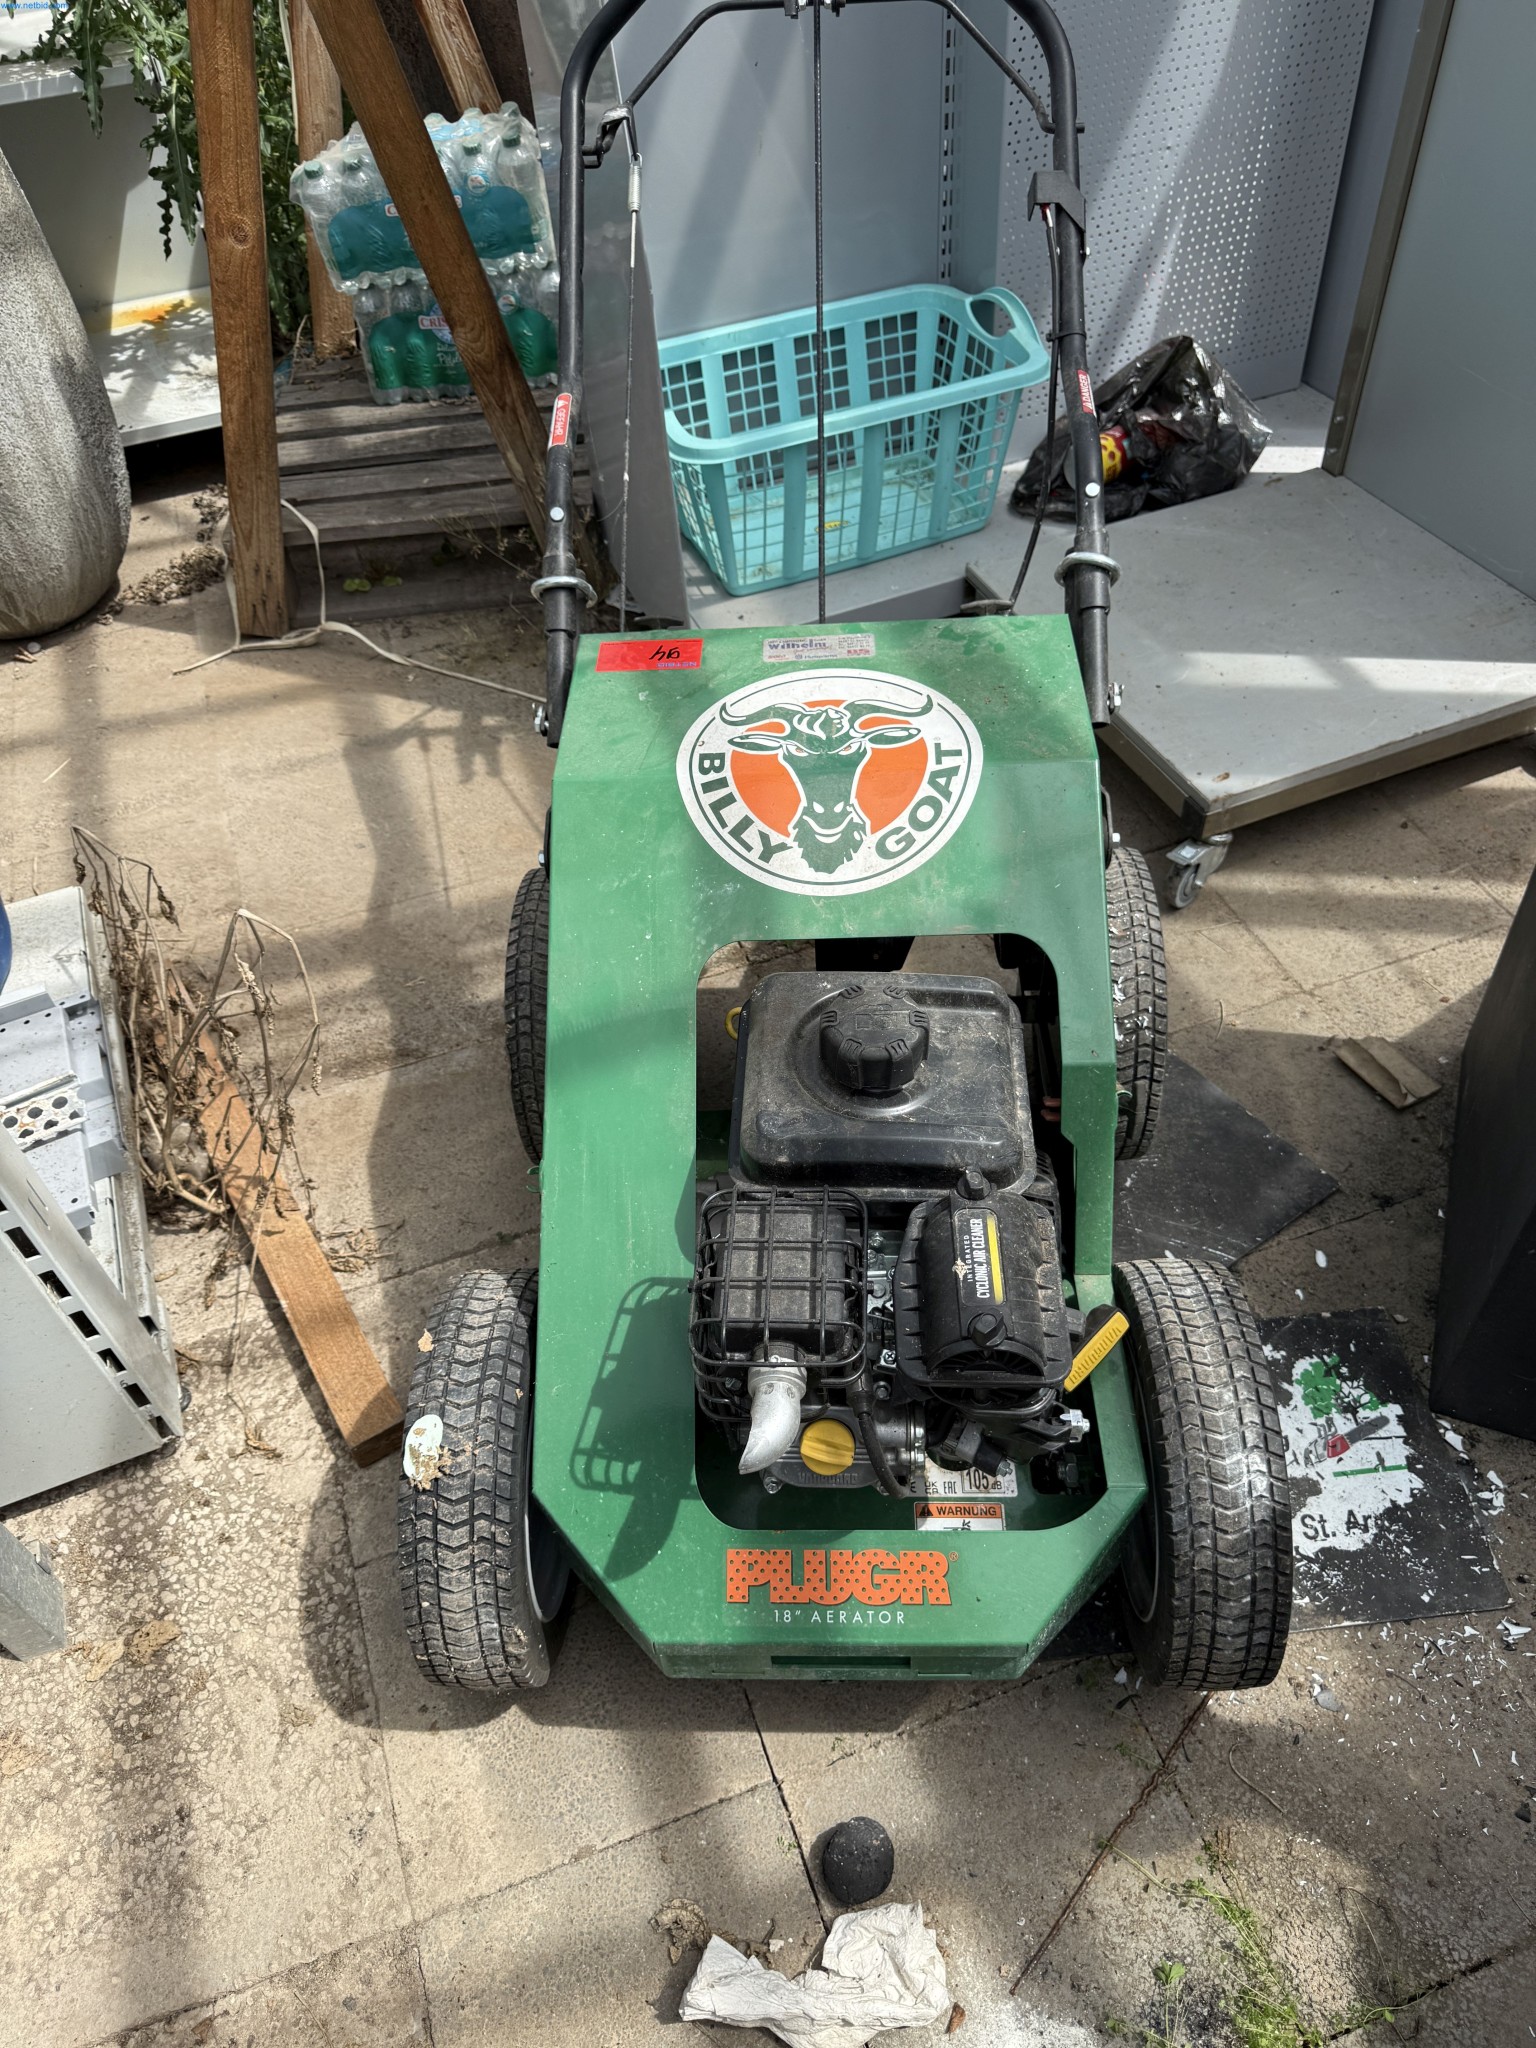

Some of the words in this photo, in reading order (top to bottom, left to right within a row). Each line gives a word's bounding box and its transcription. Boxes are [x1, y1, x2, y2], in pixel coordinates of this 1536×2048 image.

[1079, 374, 1091, 402] DANGER
[554, 408, 566, 436] GEFAHR
[698, 752, 793, 864] BILLY
[875, 743, 962, 860] GOAT
[970, 1218, 985, 1248] CLEANER
[964, 1234, 974, 1282] INTEGRATED
[972, 1249, 986, 1262] AIR
[973, 1263, 990, 1298] CYCLONIC
[943, 1481, 957, 1494] EAC
[965, 1468, 989, 1490] 105
[991, 1481, 1003, 1490] dB
[936, 1506, 997, 1516] WARNUNG
[1300, 1513, 1337, 1541] St.
[811, 1611, 905, 1624] AERATOR
